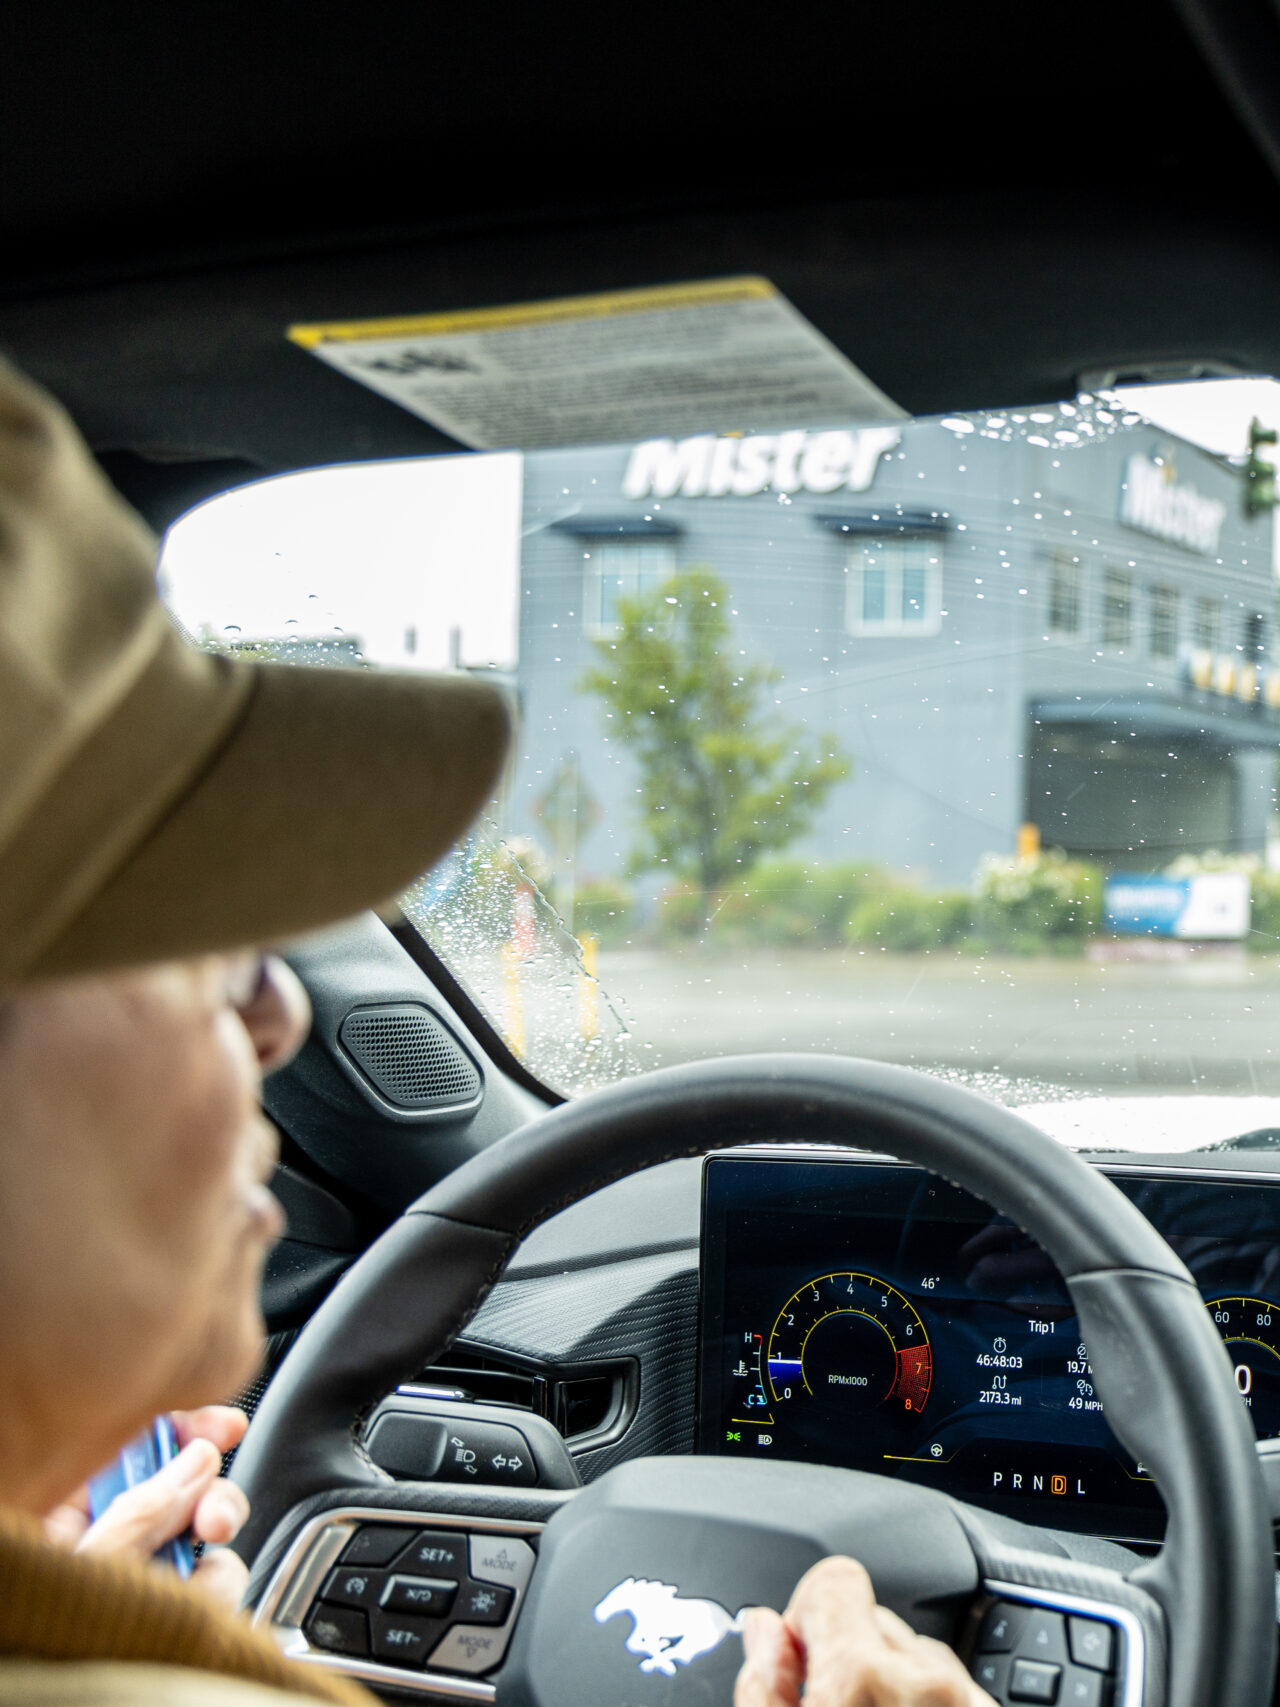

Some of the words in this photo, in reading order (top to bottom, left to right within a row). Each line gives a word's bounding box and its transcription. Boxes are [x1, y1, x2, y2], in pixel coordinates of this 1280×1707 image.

[621, 427, 900, 499] Mister
[847, 1284, 854, 1295] 4
[921, 1277, 940, 1290] 46°
[813, 1291, 820, 1302] 3
[881, 1297, 888, 1307] 5
[788, 1315, 795, 1326] 2
[1215, 1312, 1230, 1323] 60
[1256, 1314, 1271, 1326] 80
[906, 1325, 913, 1336] 6
[1028, 1320, 1049, 1335] Trip
[1050, 1322, 1055, 1334] 1
[745, 1332, 752, 1343] H
[976, 1354, 1023, 1368] 46:48:03
[916, 1363, 922, 1374] 7
[1067, 1361, 1087, 1374] 19.7
[828, 1375, 868, 1386] RPMx1000
[1234, 1364, 1252, 1395] 0
[748, 1394, 755, 1405] C
[784, 1388, 792, 1399] 0
[979, 1391, 1010, 1405] 2173.3
[1011, 1396, 1022, 1405] mi
[905, 1399, 912, 1410] 8
[1068, 1397, 1083, 1409] 49
[1085, 1400, 1103, 1411] MPH
[993, 1472, 1003, 1487] P
[1013, 1473, 1023, 1489] R
[1033, 1475, 1043, 1490] N
[1054, 1477, 1064, 1492] D
[1077, 1479, 1086, 1494] L
[419, 1548, 455, 1563] SET+
[481, 1558, 518, 1571] MODE
[457, 1634, 493, 1649] MODE
